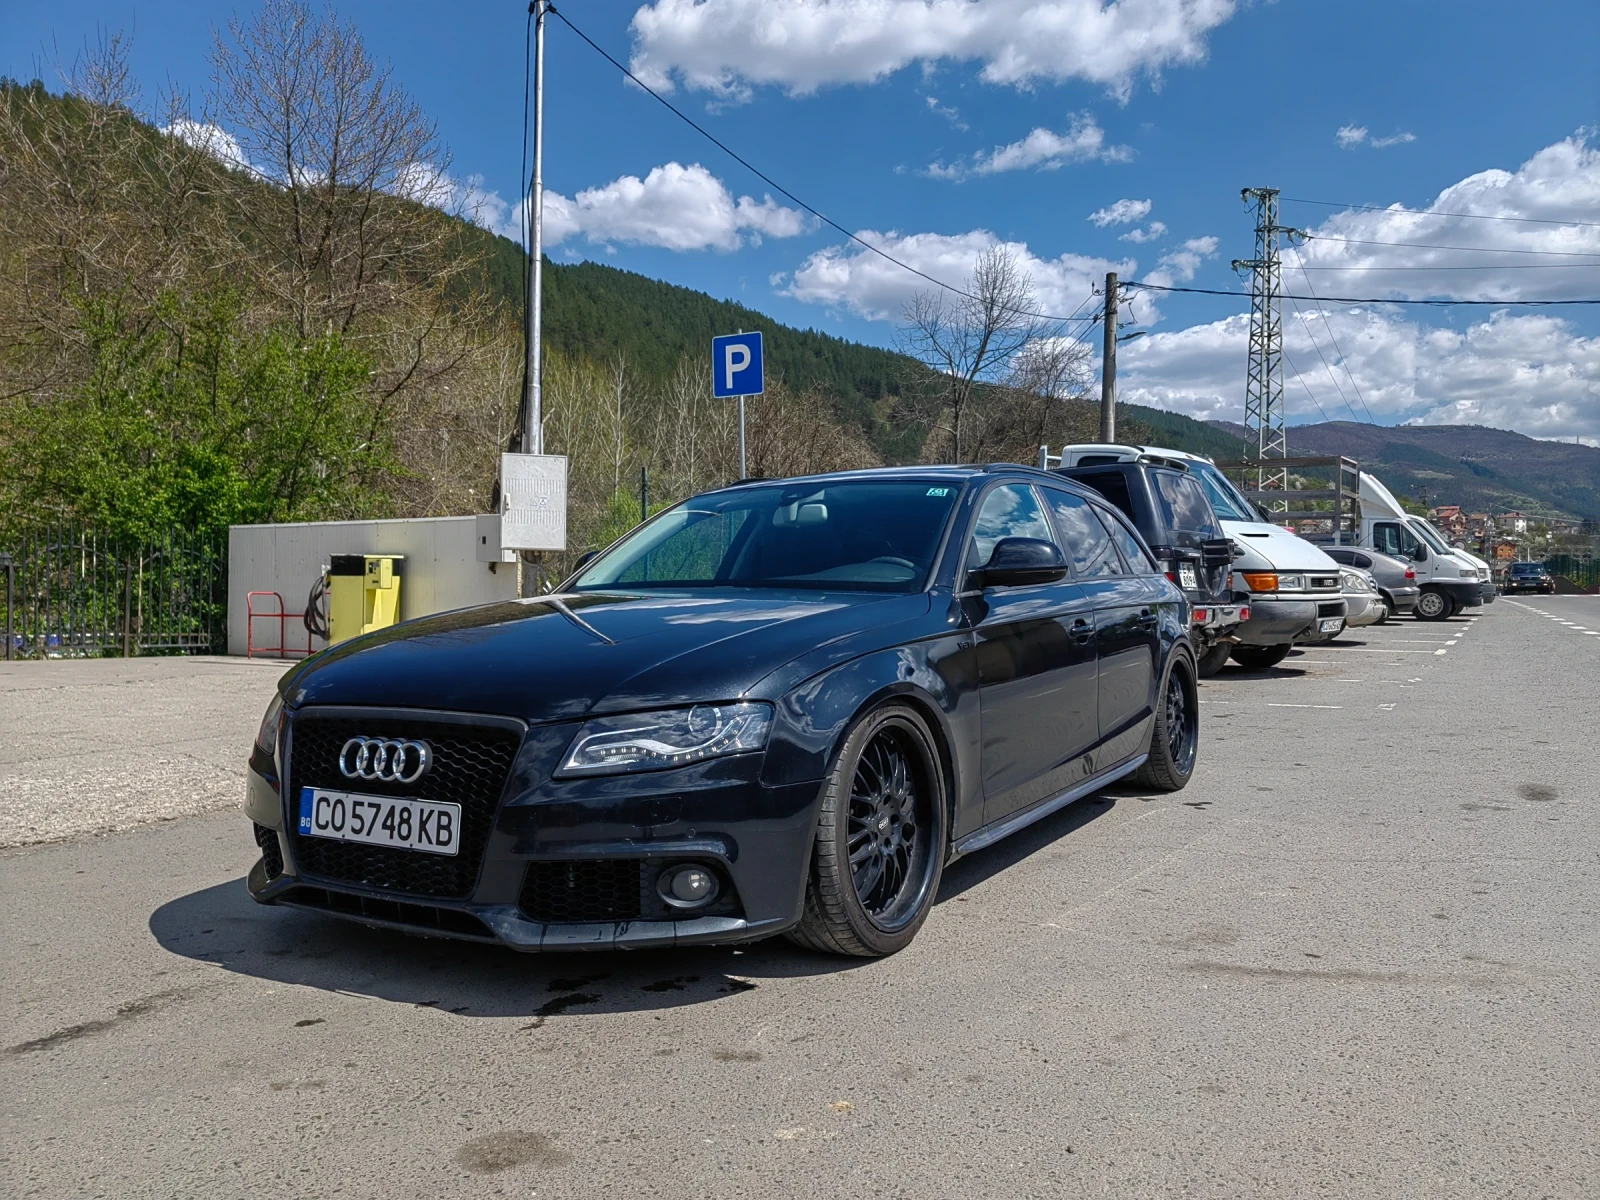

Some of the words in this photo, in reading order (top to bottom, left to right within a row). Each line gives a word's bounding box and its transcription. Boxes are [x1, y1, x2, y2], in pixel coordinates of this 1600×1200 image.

[725, 344, 751, 389] P
[300, 816, 311, 828] BG
[350, 800, 412, 841] 5748
[417, 808, 453, 847] KB
